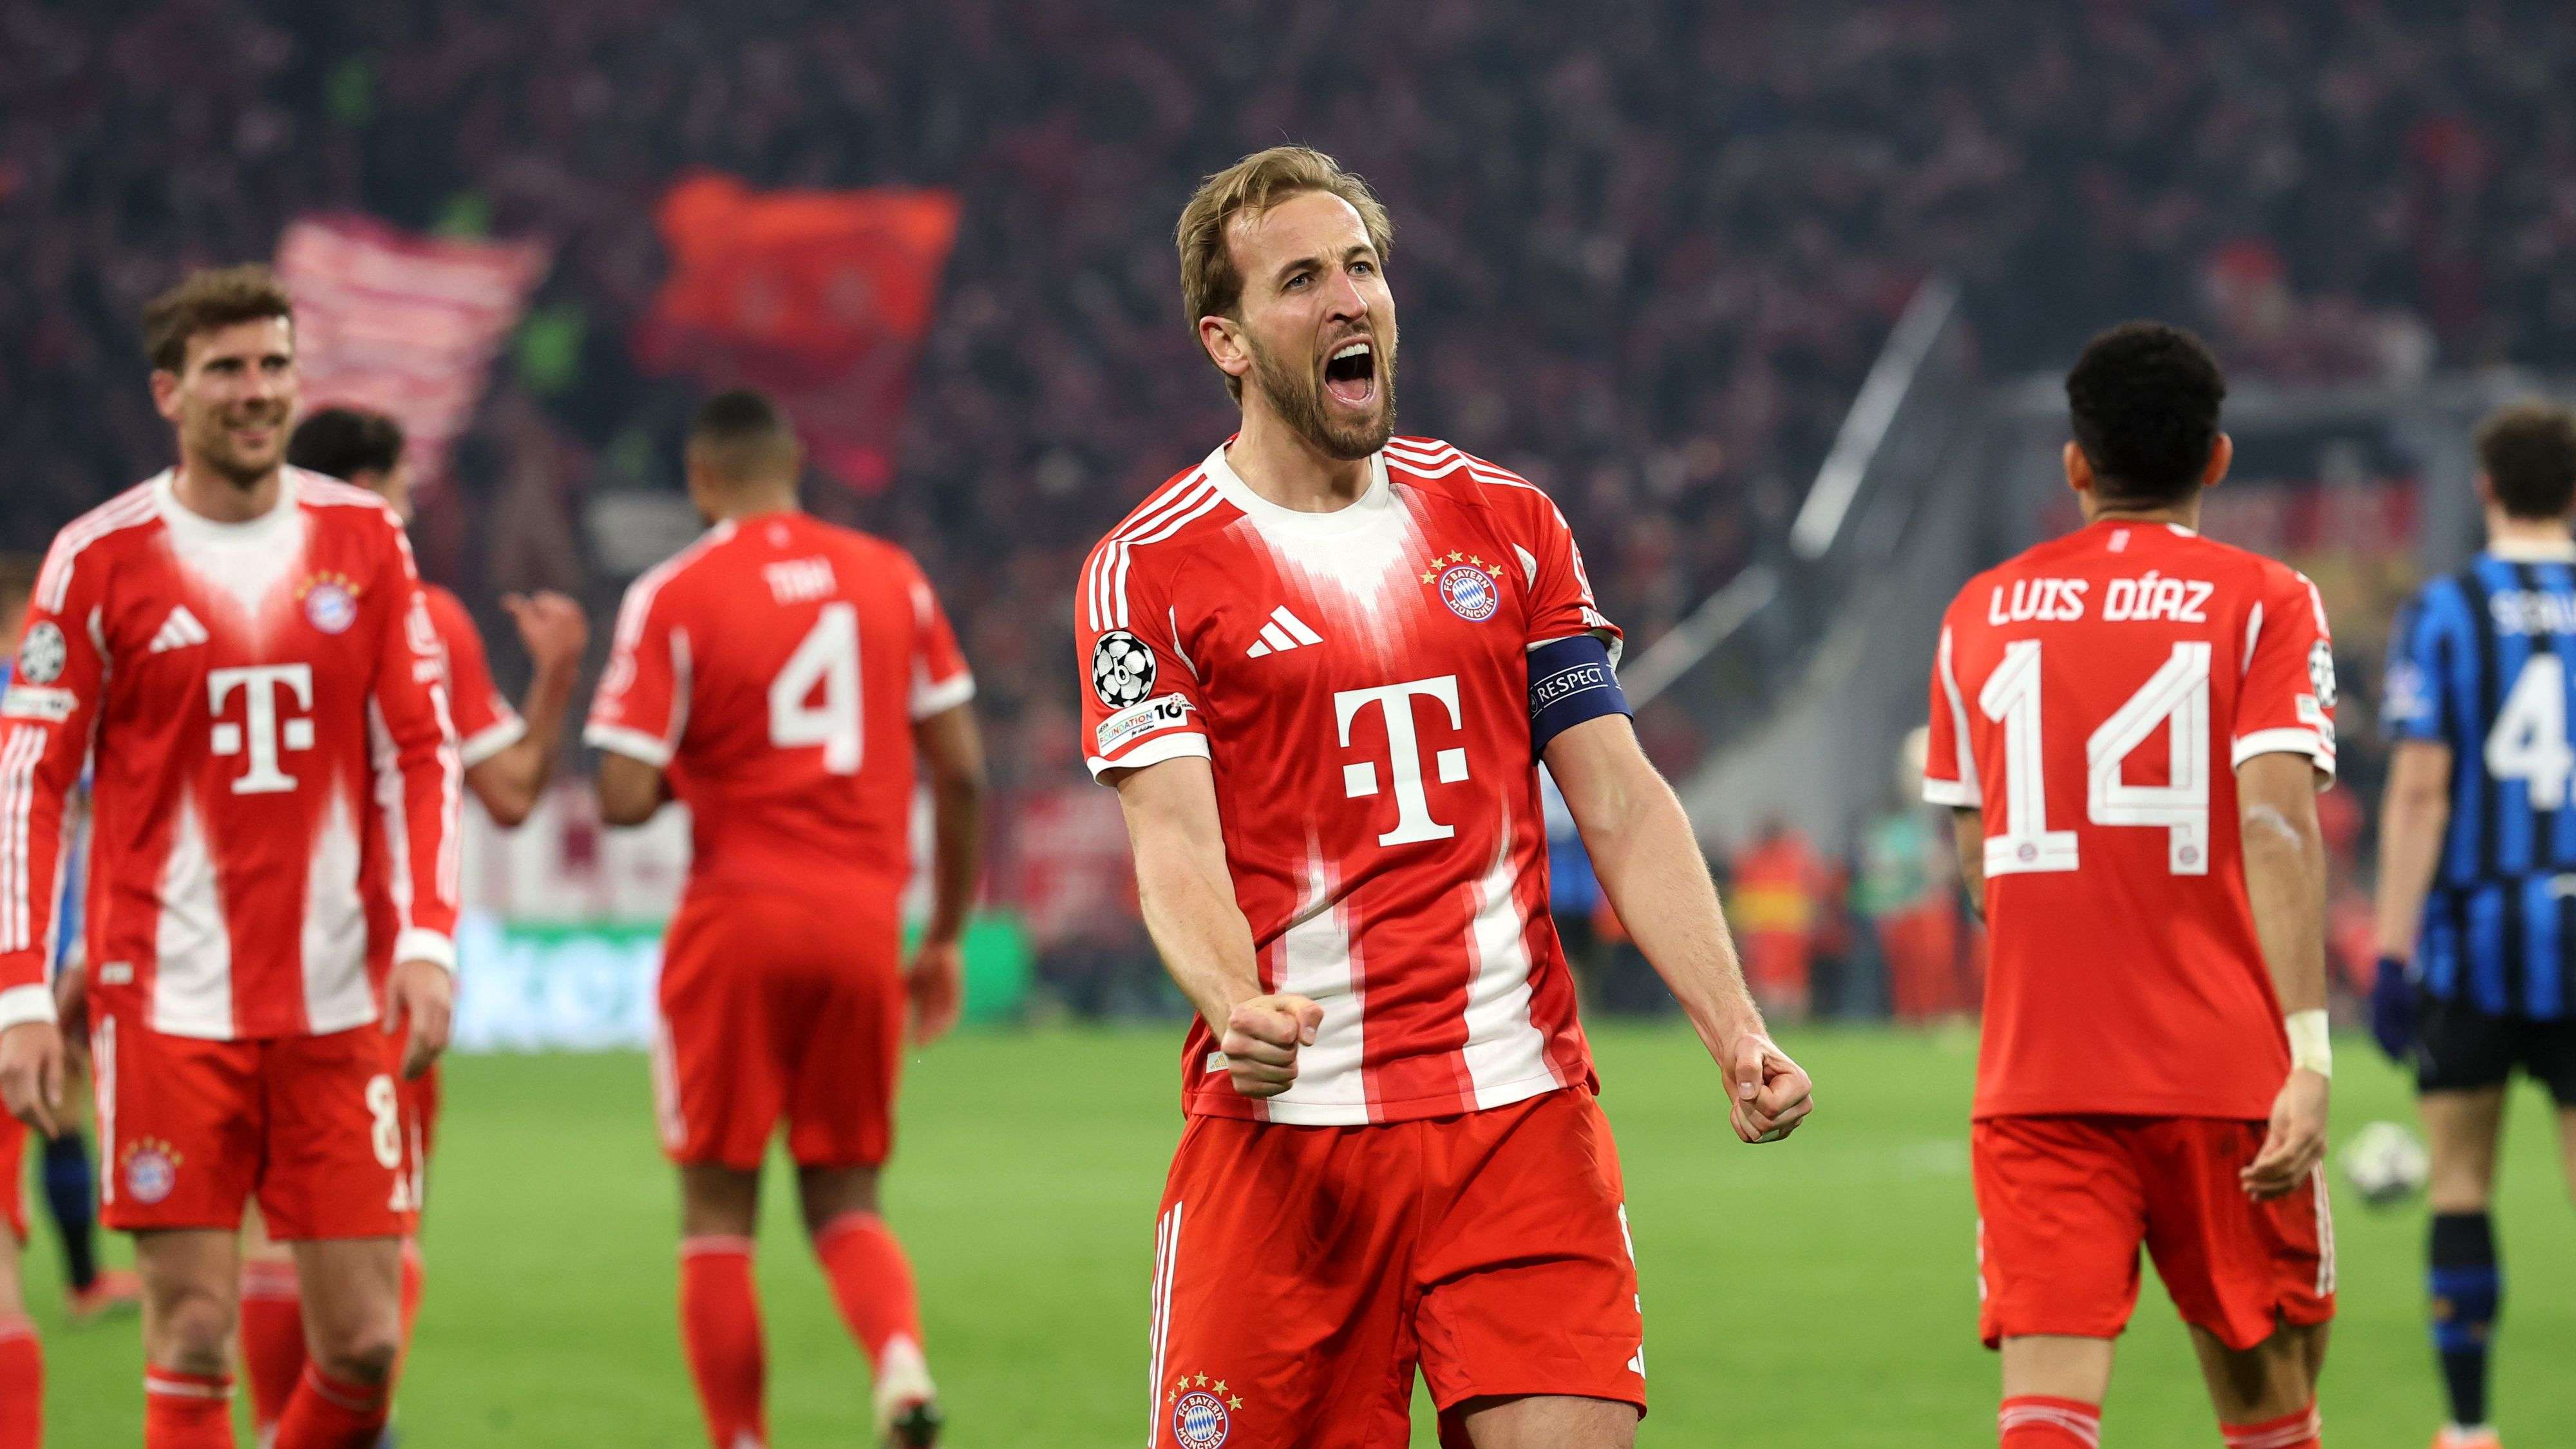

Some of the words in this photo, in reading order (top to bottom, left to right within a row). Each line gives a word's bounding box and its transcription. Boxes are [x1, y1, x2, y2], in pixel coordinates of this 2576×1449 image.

[1443, 579, 1453, 591] FC
[1450, 569, 1490, 589] BAYERN
[1449, 597, 1494, 618] MÜNCHEN
[1988, 578, 2088, 626] LUIS
[2103, 570, 2214, 623] DÍAZ
[767, 600, 864, 775] 4
[1537, 668, 1604, 703] RESPECT
[1100, 712, 1153, 746] FOUNDATION
[1978, 639, 2212, 877] 14
[365, 1074, 402, 1169] 8
[1179, 1403, 1189, 1417] FC
[1189, 1396, 1224, 1421] BAYERN
